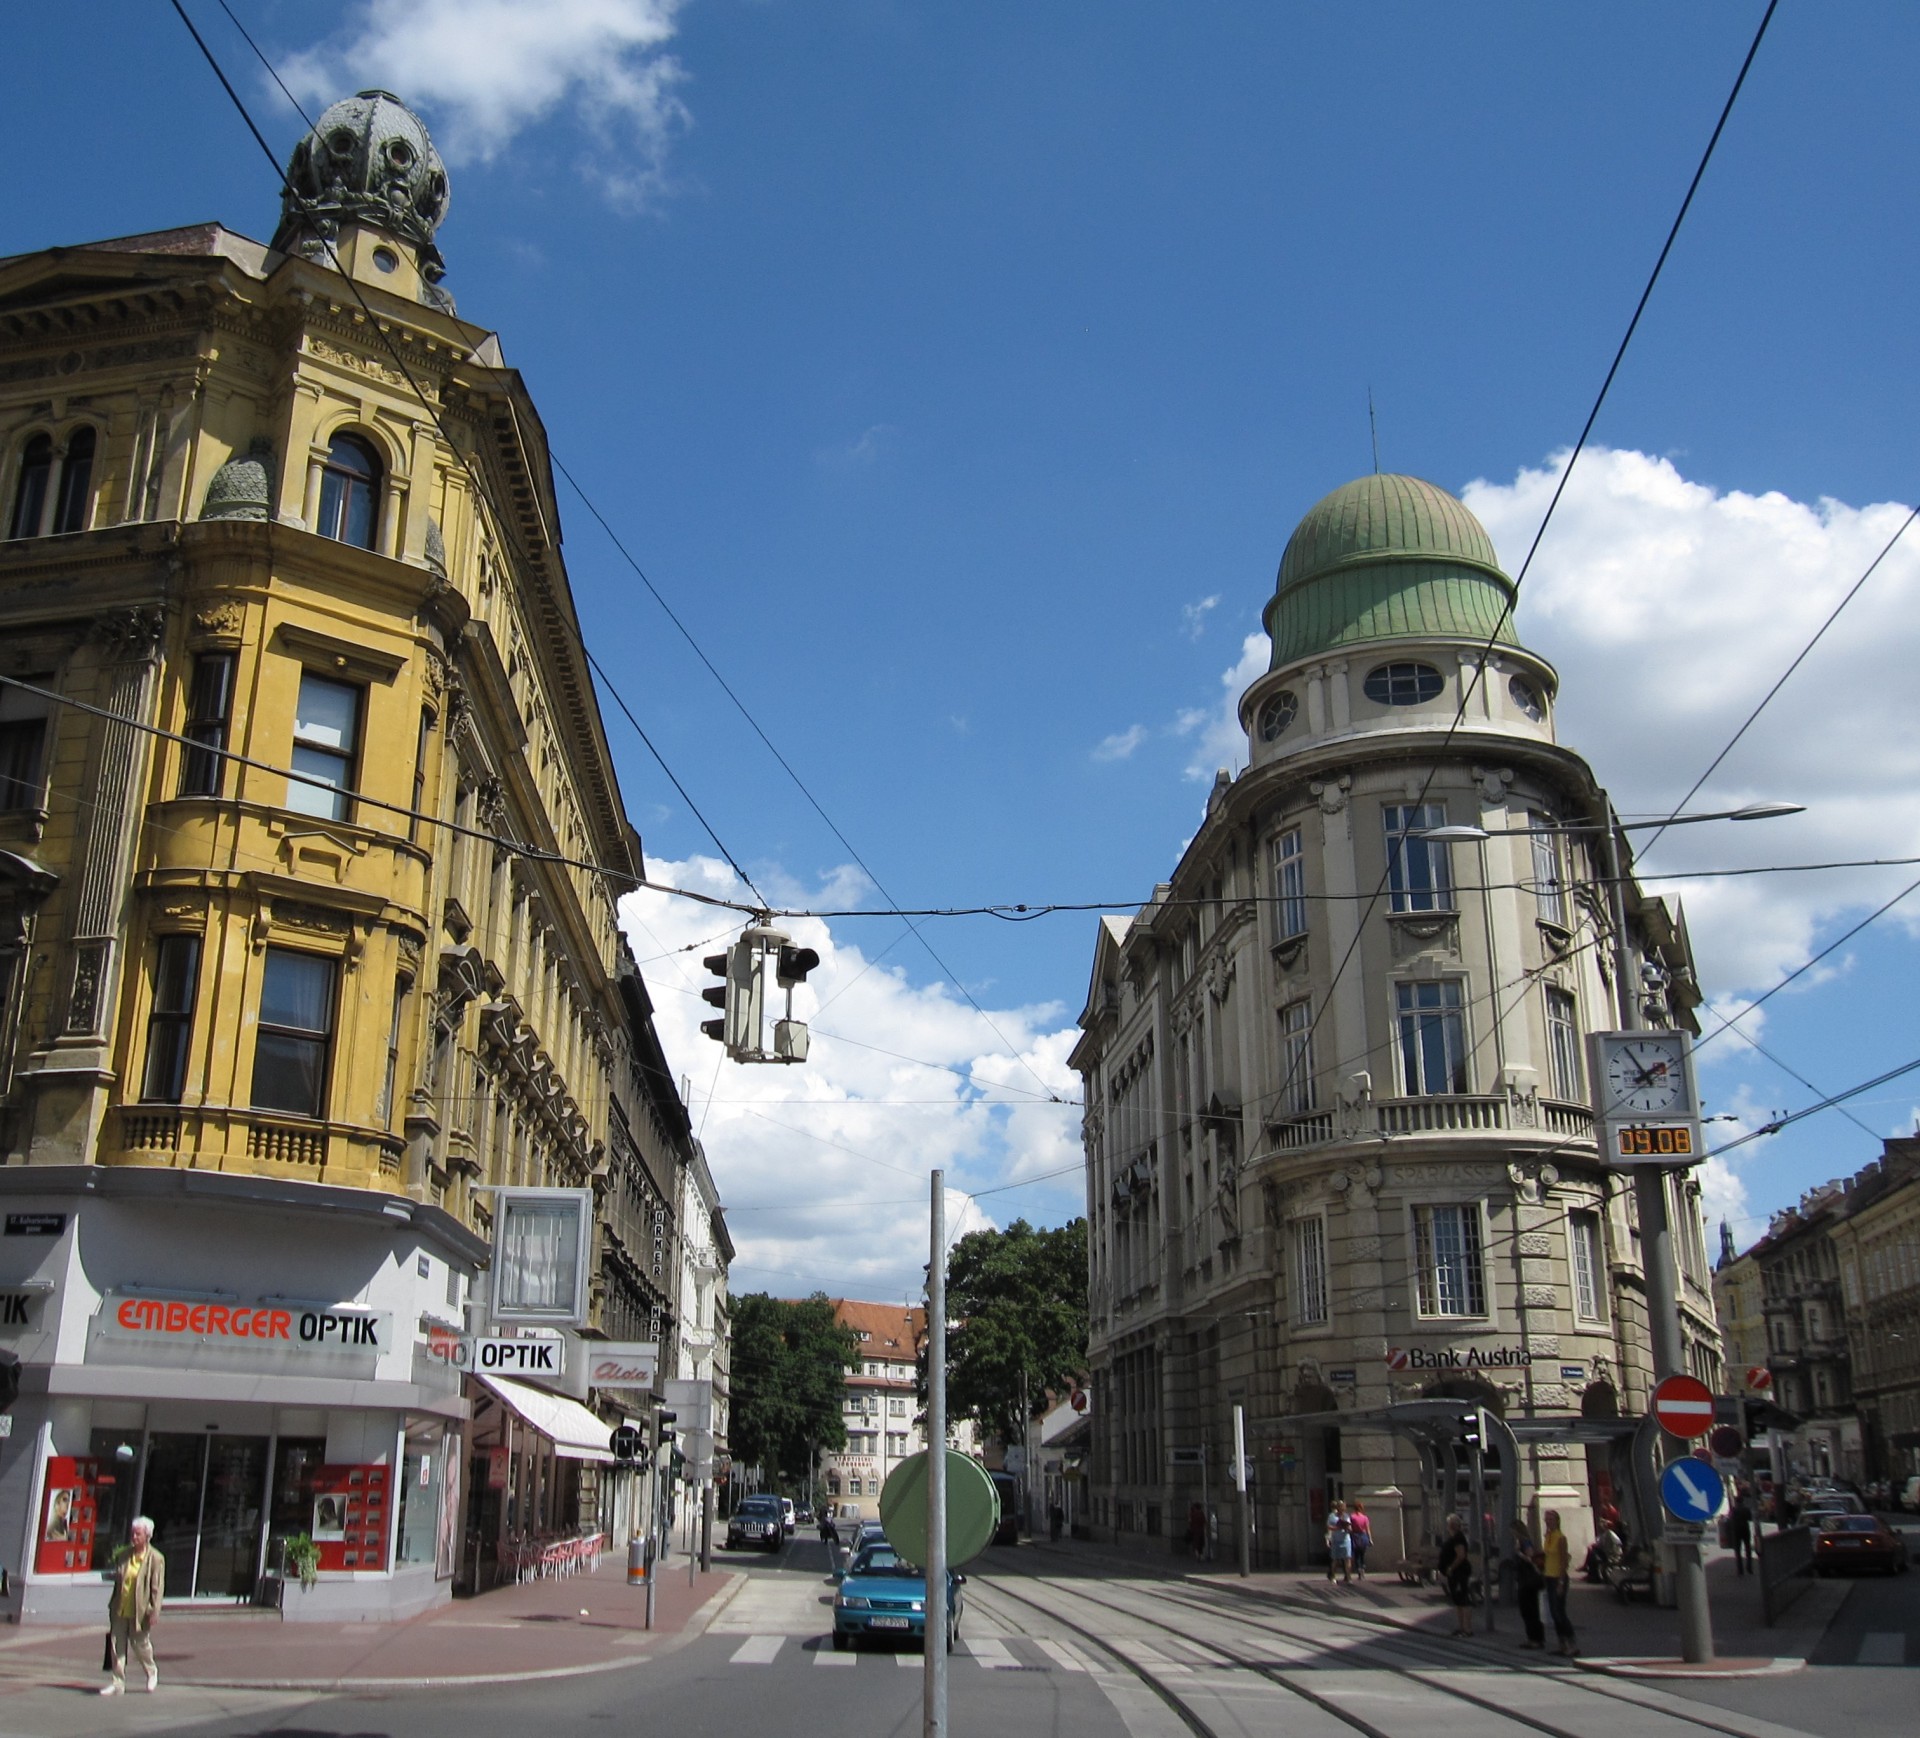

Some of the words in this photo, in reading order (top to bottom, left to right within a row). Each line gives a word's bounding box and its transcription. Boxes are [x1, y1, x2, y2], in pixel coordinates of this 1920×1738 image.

[1620, 1130, 1690, 1153] 09.08
[1394, 1164, 1495, 1181] SPARKASSE
[0, 1293, 31, 1324] IK
[117, 1299, 292, 1339] EMBERGER
[299, 1312, 379, 1345] OPTIK
[481, 1343, 553, 1369] OPTIK
[1410, 1347, 1461, 1369] Bank
[1467, 1346, 1532, 1367] Austria
